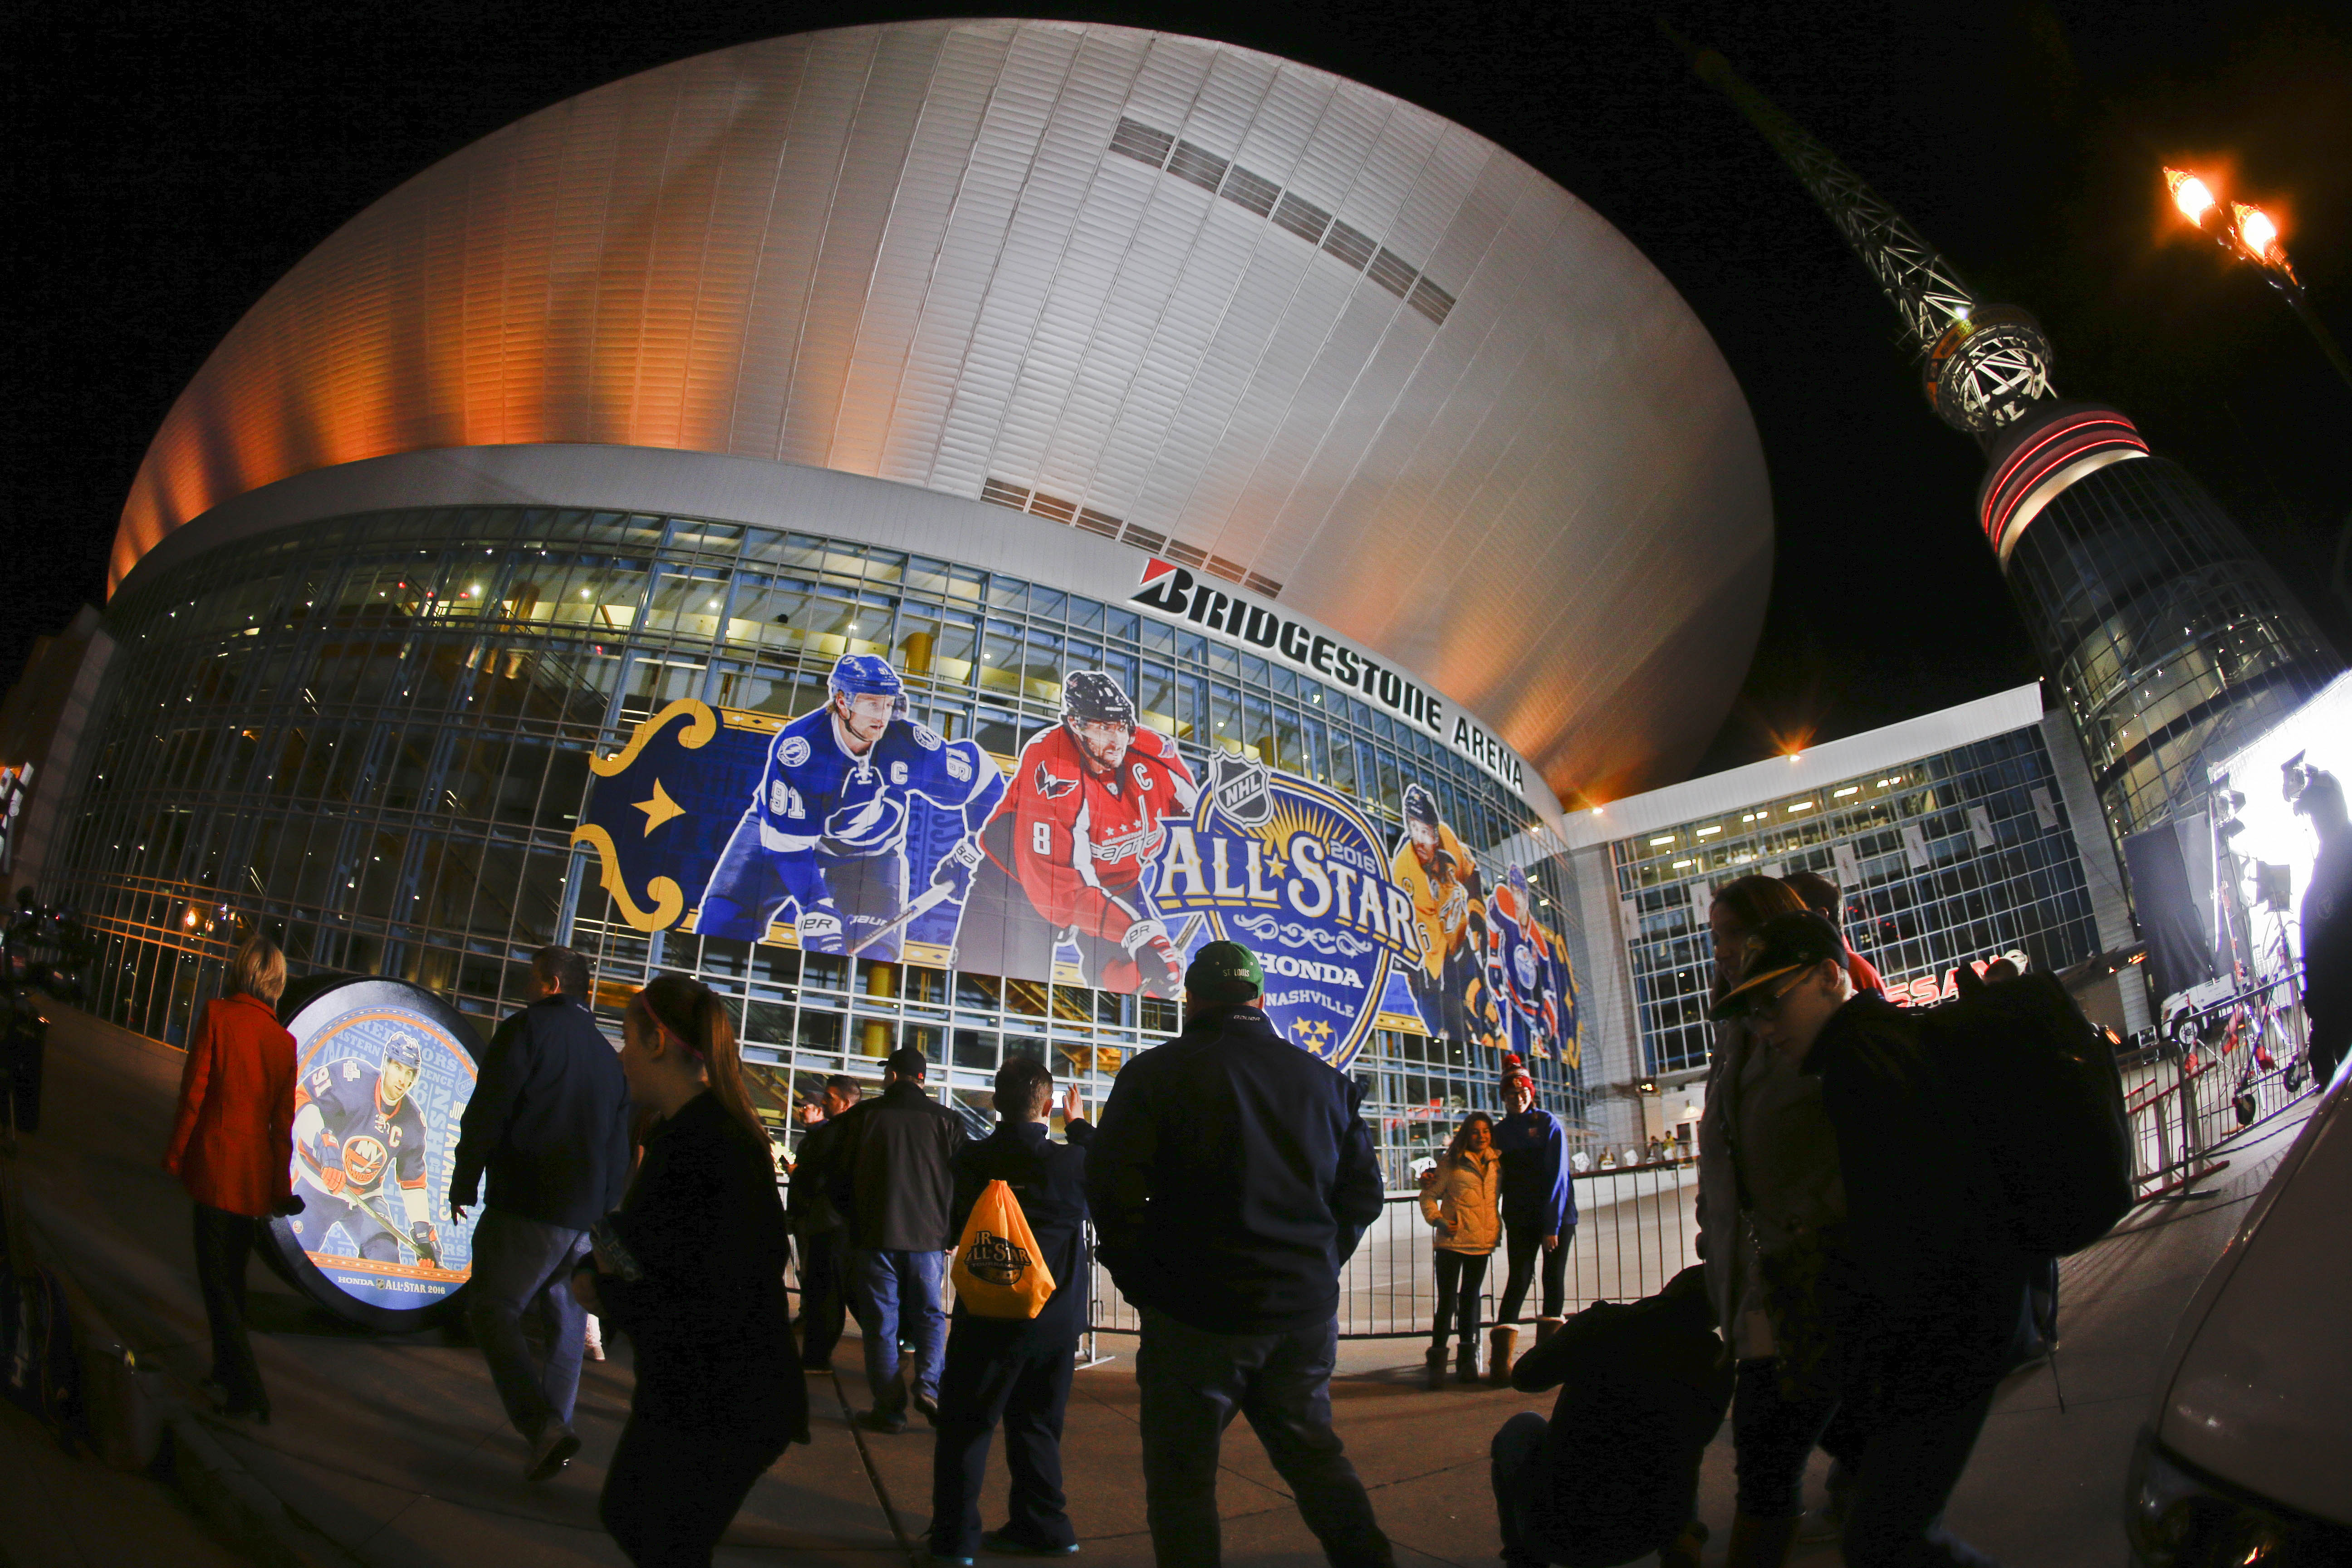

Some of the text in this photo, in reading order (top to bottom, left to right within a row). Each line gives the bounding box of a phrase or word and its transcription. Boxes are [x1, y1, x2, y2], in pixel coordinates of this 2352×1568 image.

[1128, 558, 1524, 792] BRIDGESTONE ARENA
[891, 760, 908, 785] C
[1132, 762, 1154, 791] C
[769, 779, 806, 819] 91
[1225, 774, 1261, 808] NHL
[1033, 821, 1052, 856] 8
[1329, 840, 1377, 874] 2016
[1155, 826, 1421, 955] ALL STAR
[1234, 968, 1250, 977] LOUIS
[1251, 950, 1364, 989] HONDA
[1884, 954, 2000, 1009] SSA
[1265, 990, 1355, 1019] NASHVILLE
[312, 1066, 333, 1098] 91
[449, 1100, 467, 1121] JOH
[389, 1125, 403, 1147] C
[338, 1276, 375, 1287] HONDA
